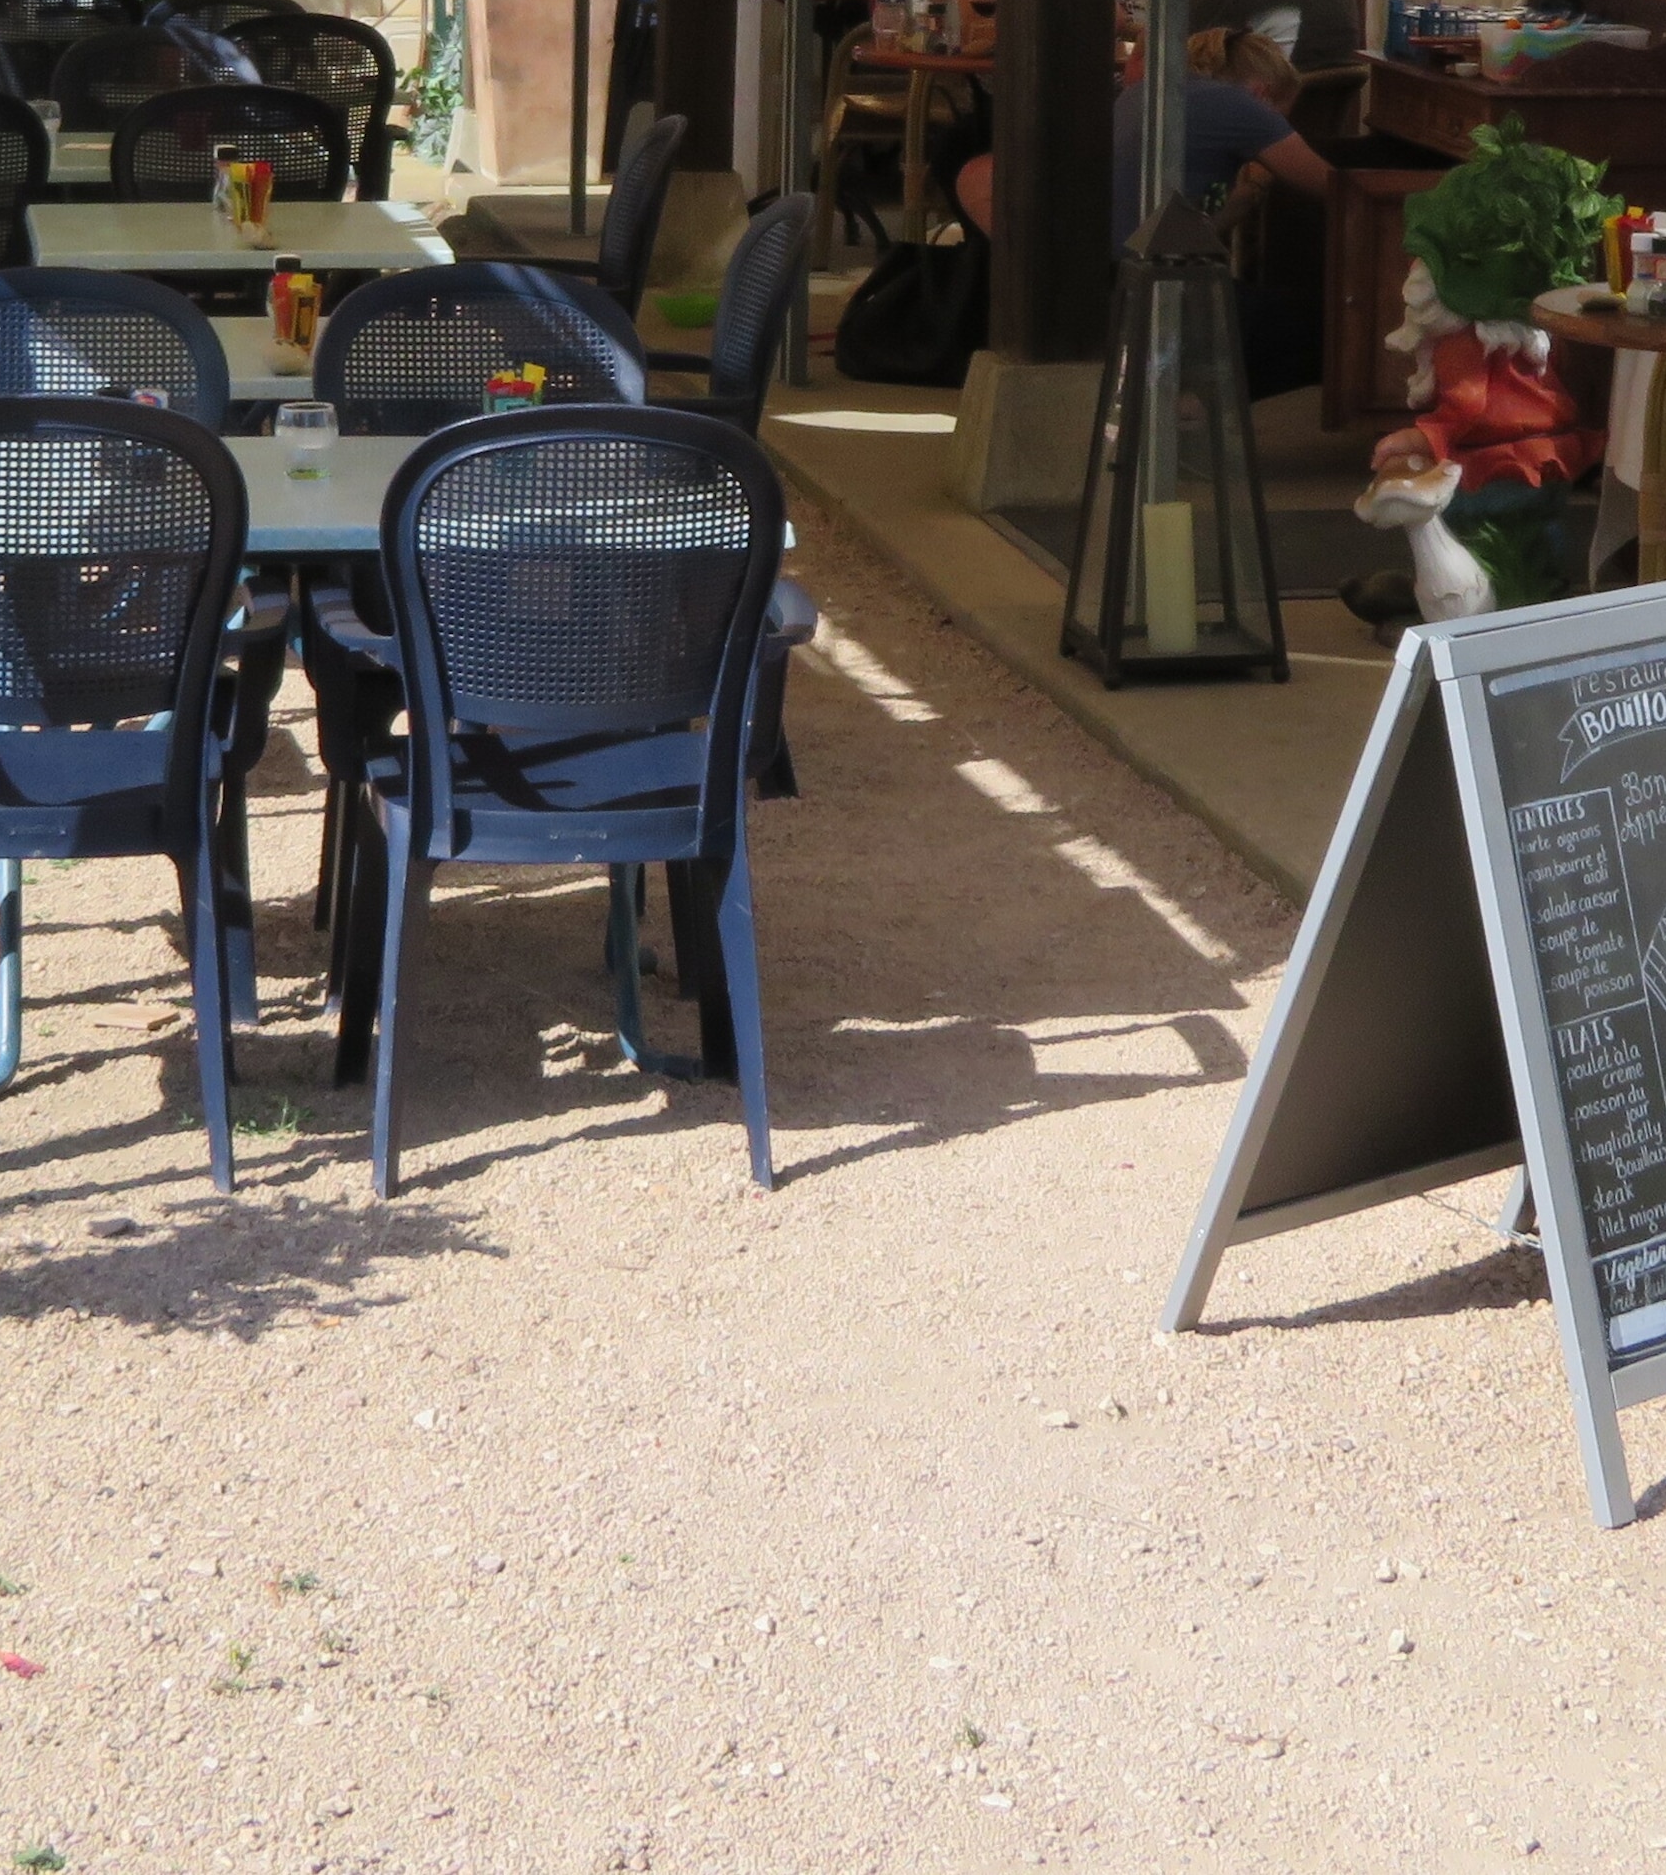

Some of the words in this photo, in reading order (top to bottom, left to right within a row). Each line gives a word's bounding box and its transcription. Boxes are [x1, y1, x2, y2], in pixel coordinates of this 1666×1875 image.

[1581, 915, 1600, 937] de
[1575, 929, 1626, 964] tomate
[1592, 957, 1610, 975] de
[1583, 972, 1635, 1009] poisson
[1557, 1015, 1614, 1058] PLATS
[1627, 1083, 1647, 1105] du
[1624, 1099, 1650, 1130] jour
